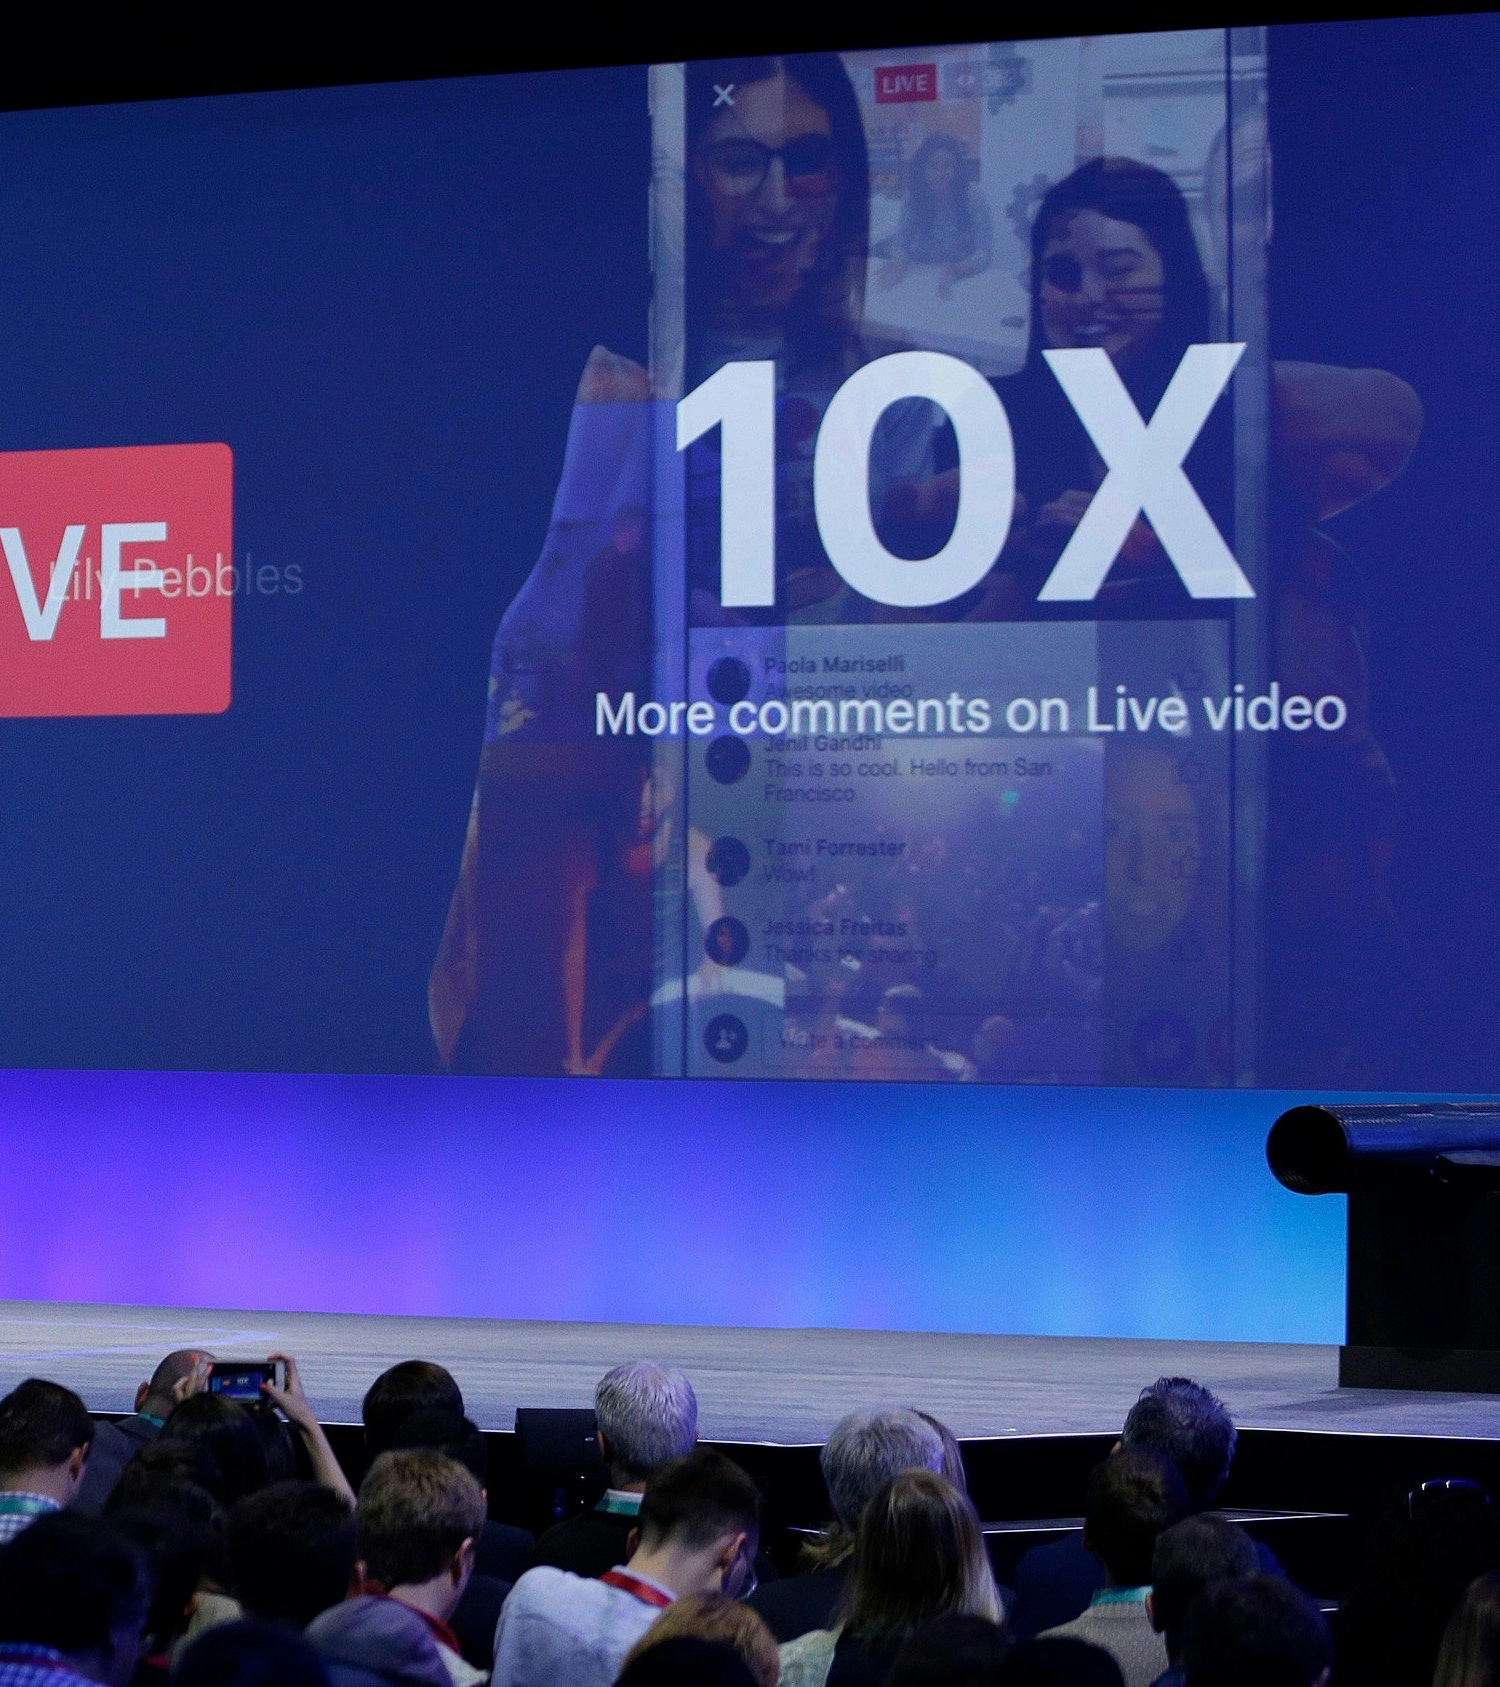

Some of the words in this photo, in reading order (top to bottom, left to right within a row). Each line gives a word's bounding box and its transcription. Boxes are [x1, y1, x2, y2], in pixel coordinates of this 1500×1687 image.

[882, 74, 929, 94] LIVE
[676, 342, 1257, 607] 10X
[133, 553, 304, 598] Pebbles
[764, 657, 816, 673] Paola
[823, 655, 905, 673] Mariselli
[863, 682, 913, 699] video
[596, 692, 715, 735] More
[729, 692, 991, 735] comments
[1006, 698, 1069, 732] on
[1087, 685, 1188, 732] Live
[1203, 682, 1347, 731] video
[814, 735, 882, 751] Gandhi
[764, 758, 803, 777] This
[808, 759, 824, 777] is
[830, 761, 852, 777] so
[910, 758, 958, 776] Hello
[965, 757, 1008, 776] from
[1014, 757, 1053, 776] San
[764, 783, 856, 802] Francisco
[763, 838, 811, 856] Tami
[816, 838, 907, 857] Forrester
